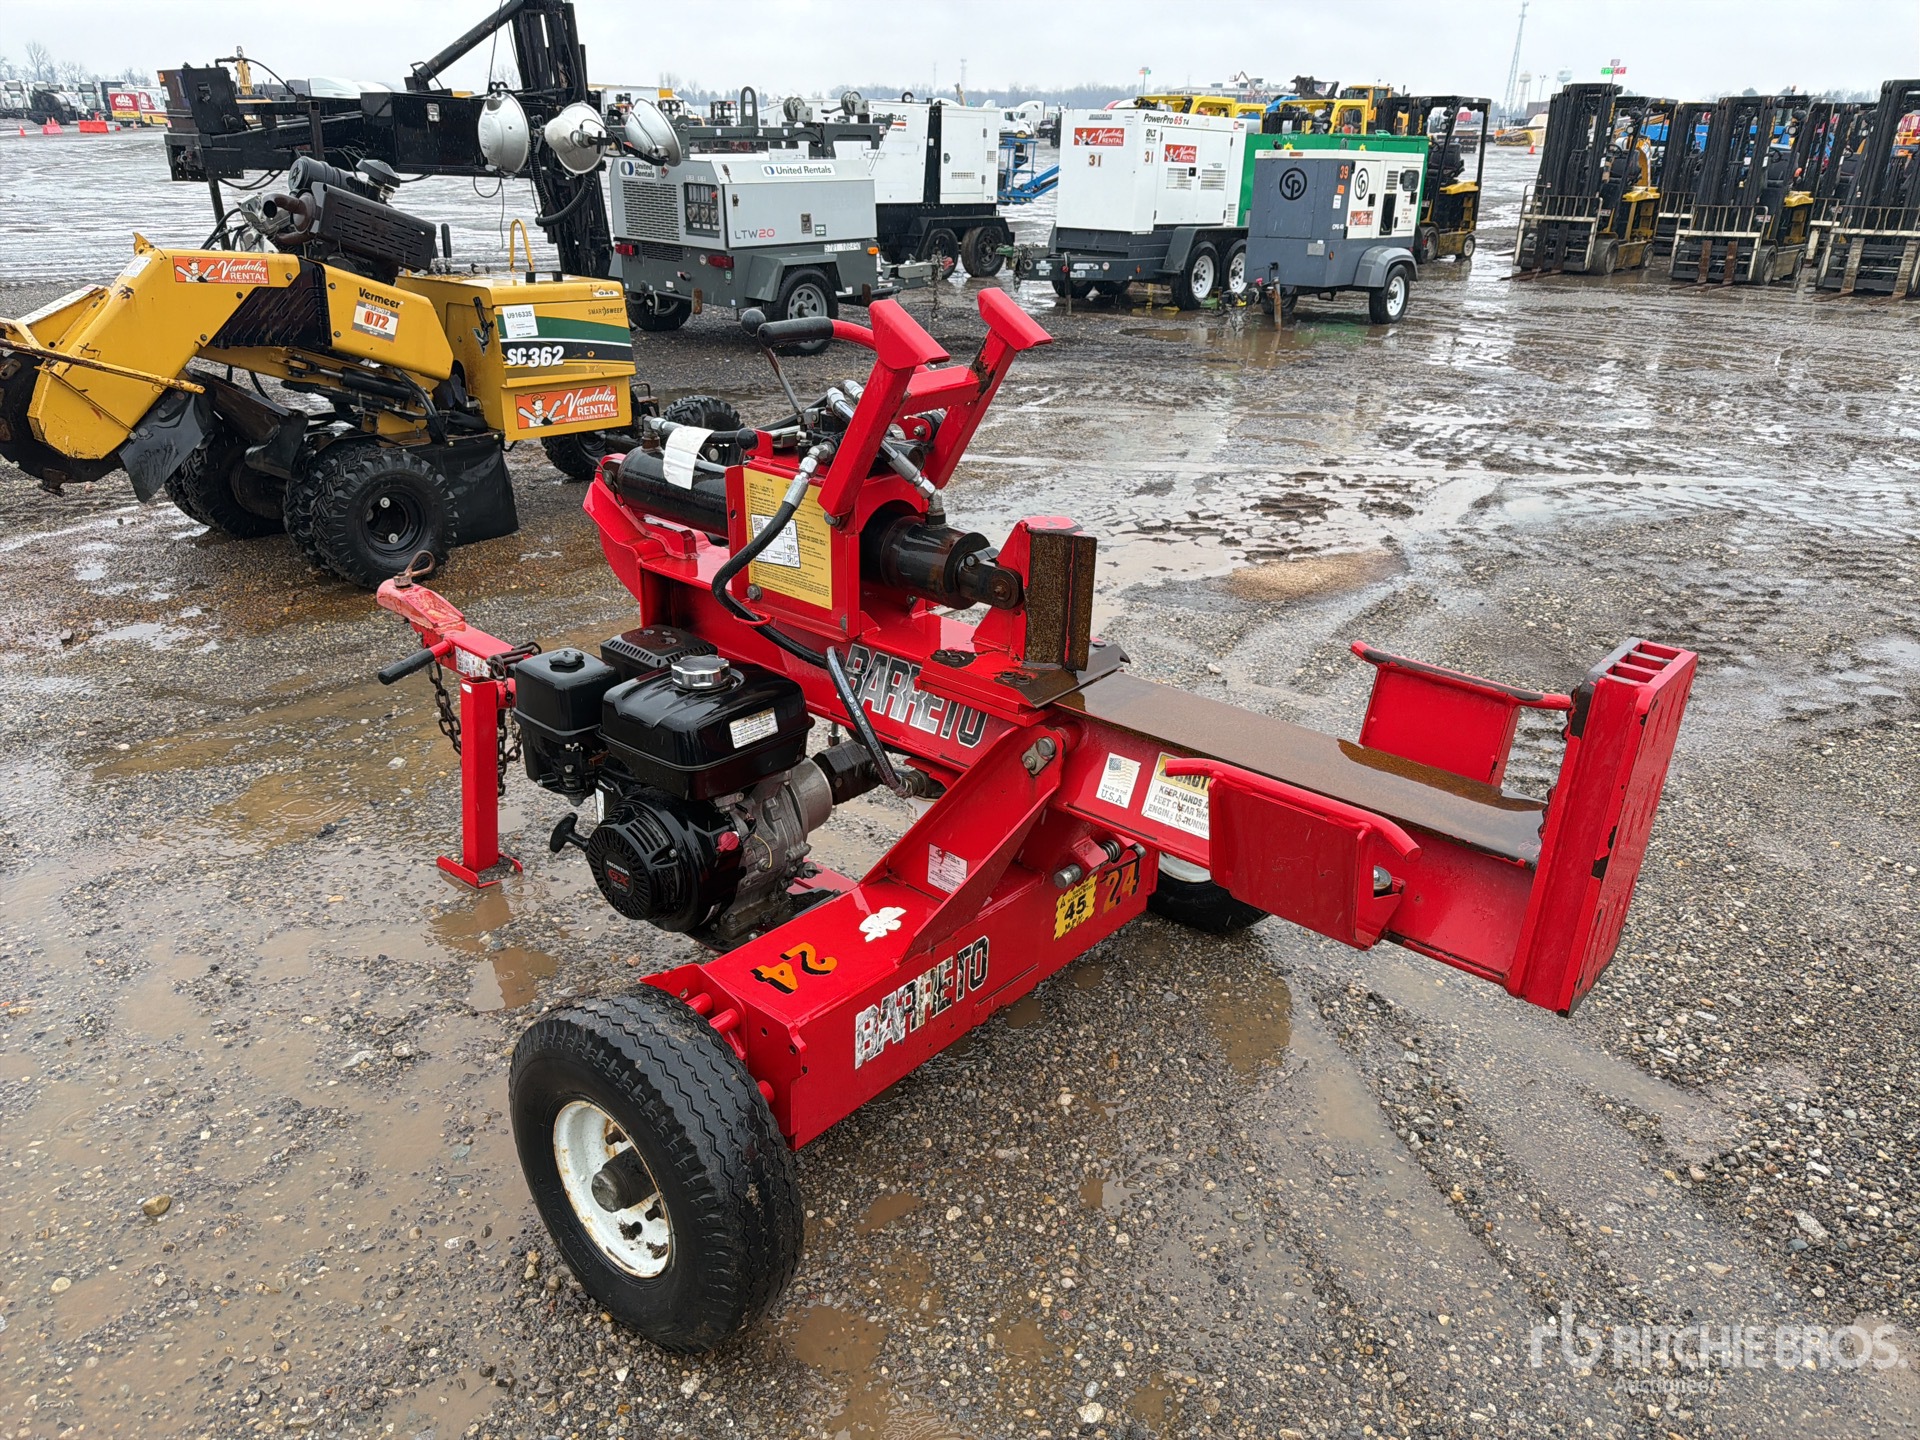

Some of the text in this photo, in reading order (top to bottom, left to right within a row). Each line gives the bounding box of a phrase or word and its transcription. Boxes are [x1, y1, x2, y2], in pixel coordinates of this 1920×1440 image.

[873, 114, 907, 122] GENRAC
[1143, 113, 1174, 125] PowerPro
[1173, 116, 1183, 125] 65
[1088, 154, 1102, 168] 31
[1144, 151, 1154, 164] 31
[635, 162, 653, 171] United
[776, 163, 832, 175] United Rentals
[1339, 165, 1349, 180] 39
[635, 170, 655, 179] Rentals
[734, 228, 776, 239] LTW20
[217, 259, 266, 279] Vandalia
[230, 272, 266, 280] RENTAL
[359, 287, 400, 309] Vermeer
[364, 311, 390, 330] 072
[506, 345, 565, 368] SC362
[563, 387, 616, 417] Vandalia
[577, 404, 616, 416] RENTAL
[1154, 795, 1171, 807] FEET
[1159, 785, 1178, 798] KEEP
[1180, 791, 1203, 807] HANDS
[606, 860, 630, 876] HONDA
[608, 869, 630, 887] GX
[1102, 860, 1140, 914] 24
[1064, 894, 1087, 920] 45
[750, 941, 838, 995] 24
[855, 935, 979, 1070] BARRETO
